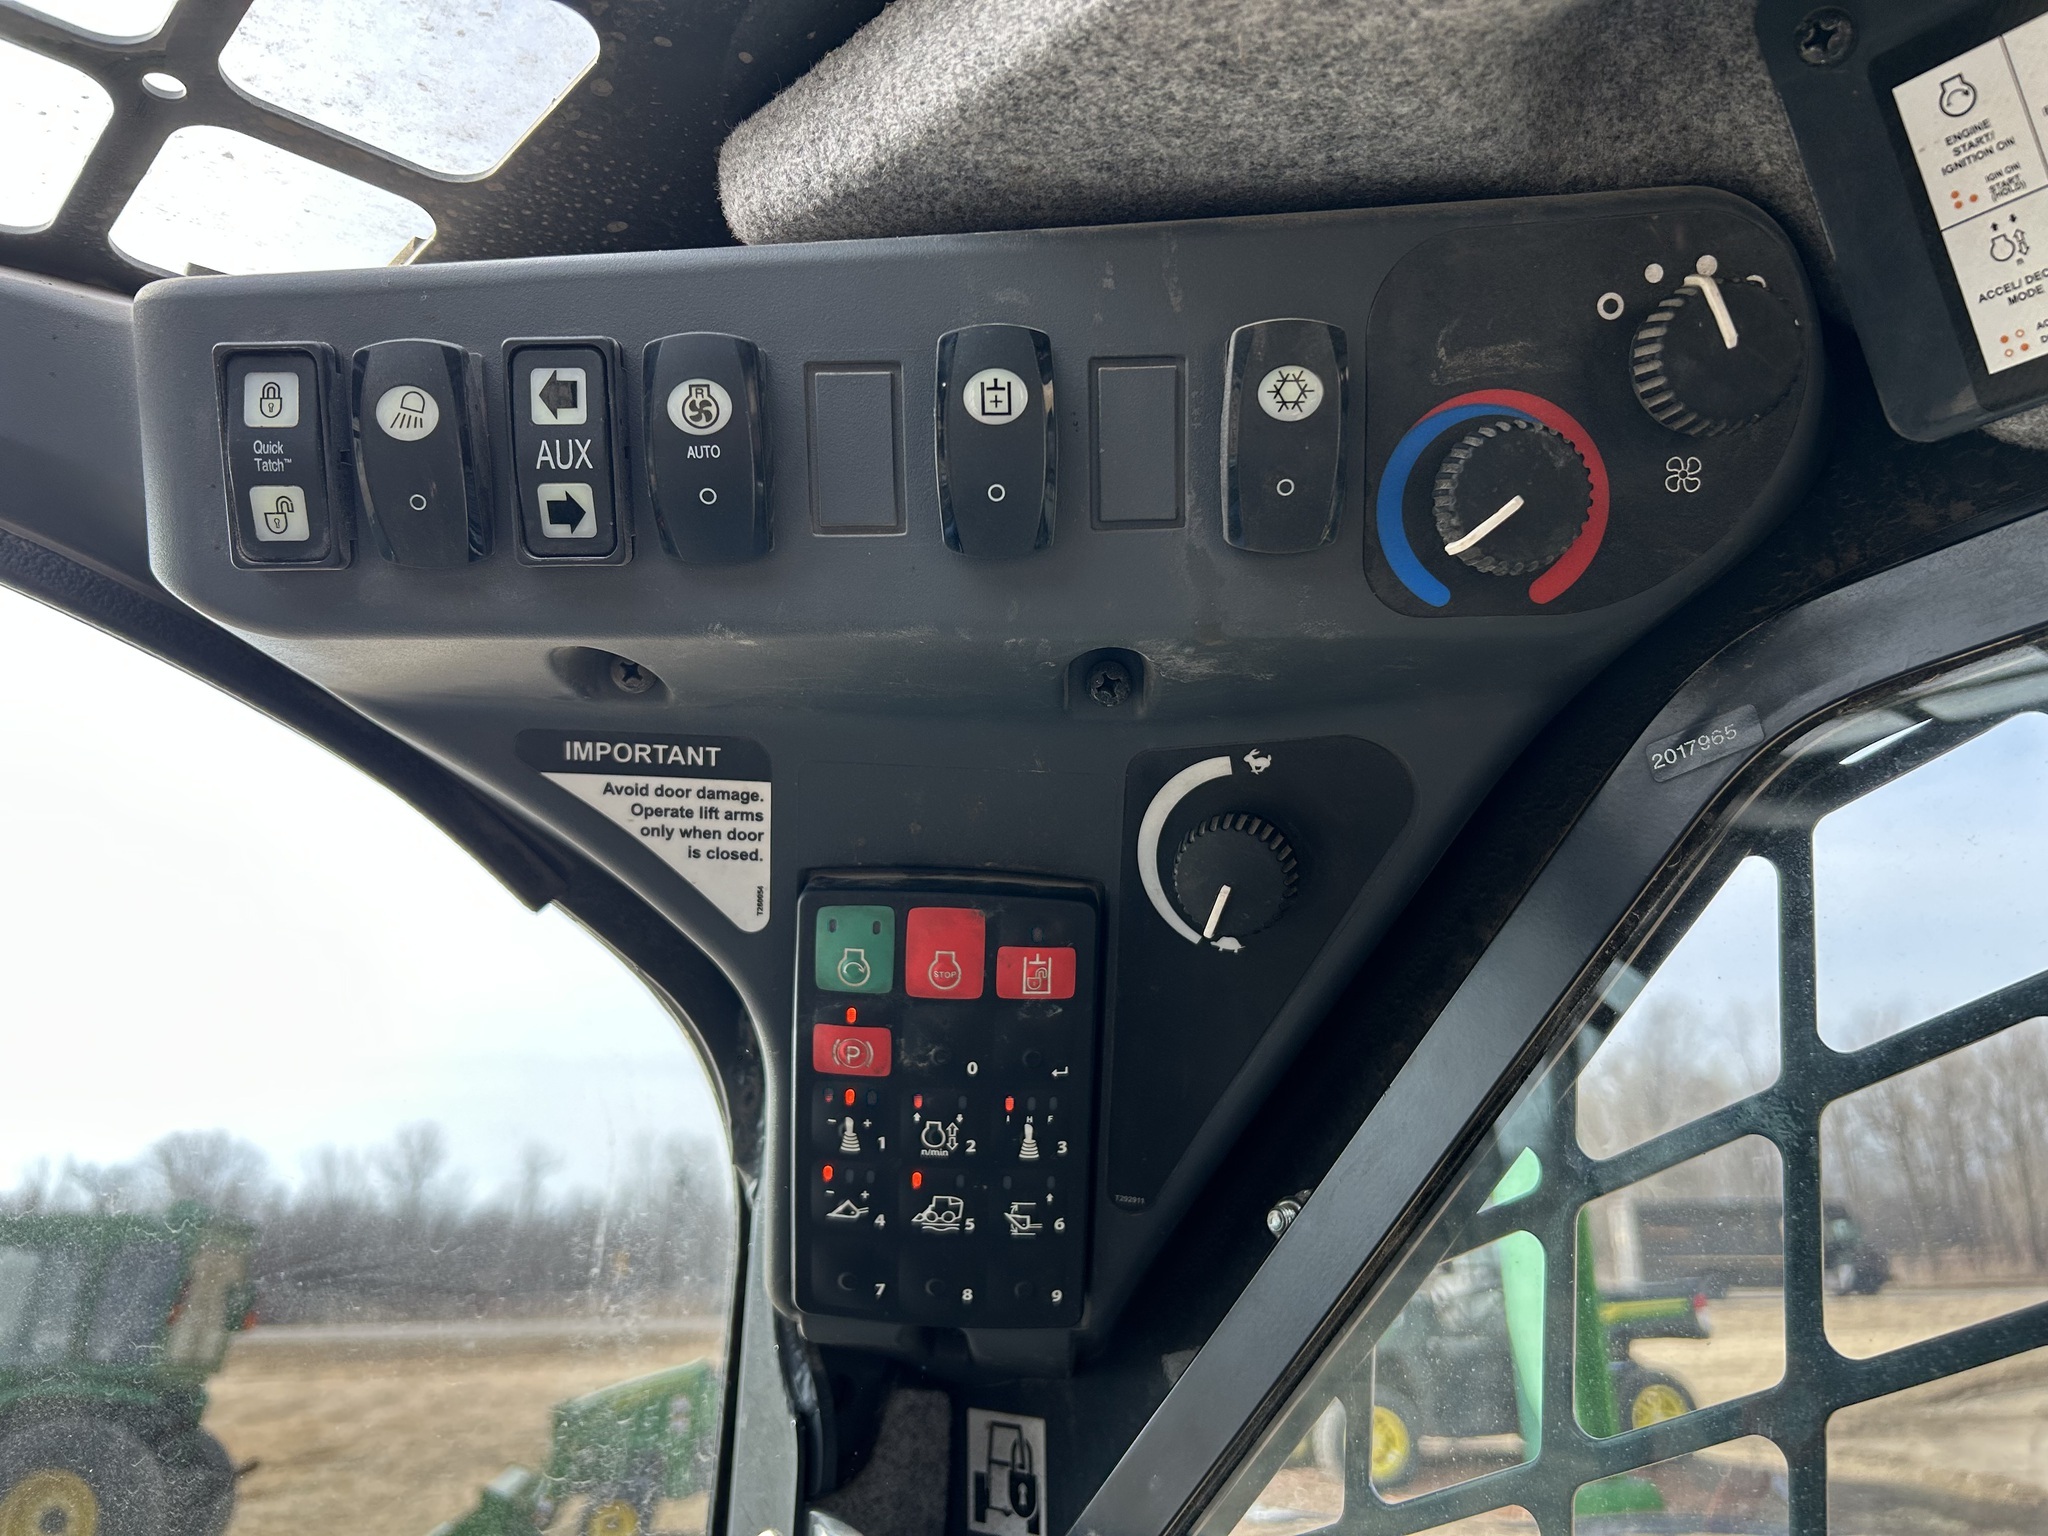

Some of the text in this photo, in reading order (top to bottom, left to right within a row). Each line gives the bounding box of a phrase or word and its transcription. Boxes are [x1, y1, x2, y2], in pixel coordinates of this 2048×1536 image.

[1944, 118, 1991, 146] ENGINE
[1941, 136, 2016, 176] IGNITION ON
[2004, 161, 2021, 174] ON
[2007, 284, 2045, 306] MODE
[253, 439, 284, 454] Quick
[536, 438, 593, 470] AUX
[687, 444, 721, 459] AUTO
[564, 740, 722, 767] IMPORTANT
[1651, 723, 1737, 770] 2017965
[603, 782, 764, 805] Avoid door damage.
[631, 803, 764, 822] Operate lift arms
[641, 825, 764, 842] only when door
[687, 845, 764, 862] is closed.
[933, 970, 957, 979] STOP
[1026, 1115, 1034, 1123] H
[1047, 1115, 1054, 1123] F
[877, 1136, 886, 1150] 1
[965, 1140, 977, 1153] 2
[1057, 1140, 1068, 1154] 3
[921, 1148, 949, 1157] n/min
[873, 1213, 887, 1229] 4
[964, 1218, 976, 1231] 5
[1053, 1217, 1065, 1231] 6
[874, 1282, 886, 1297] 7
[961, 1288, 973, 1301] 8
[1051, 1289, 1063, 1302] 9
